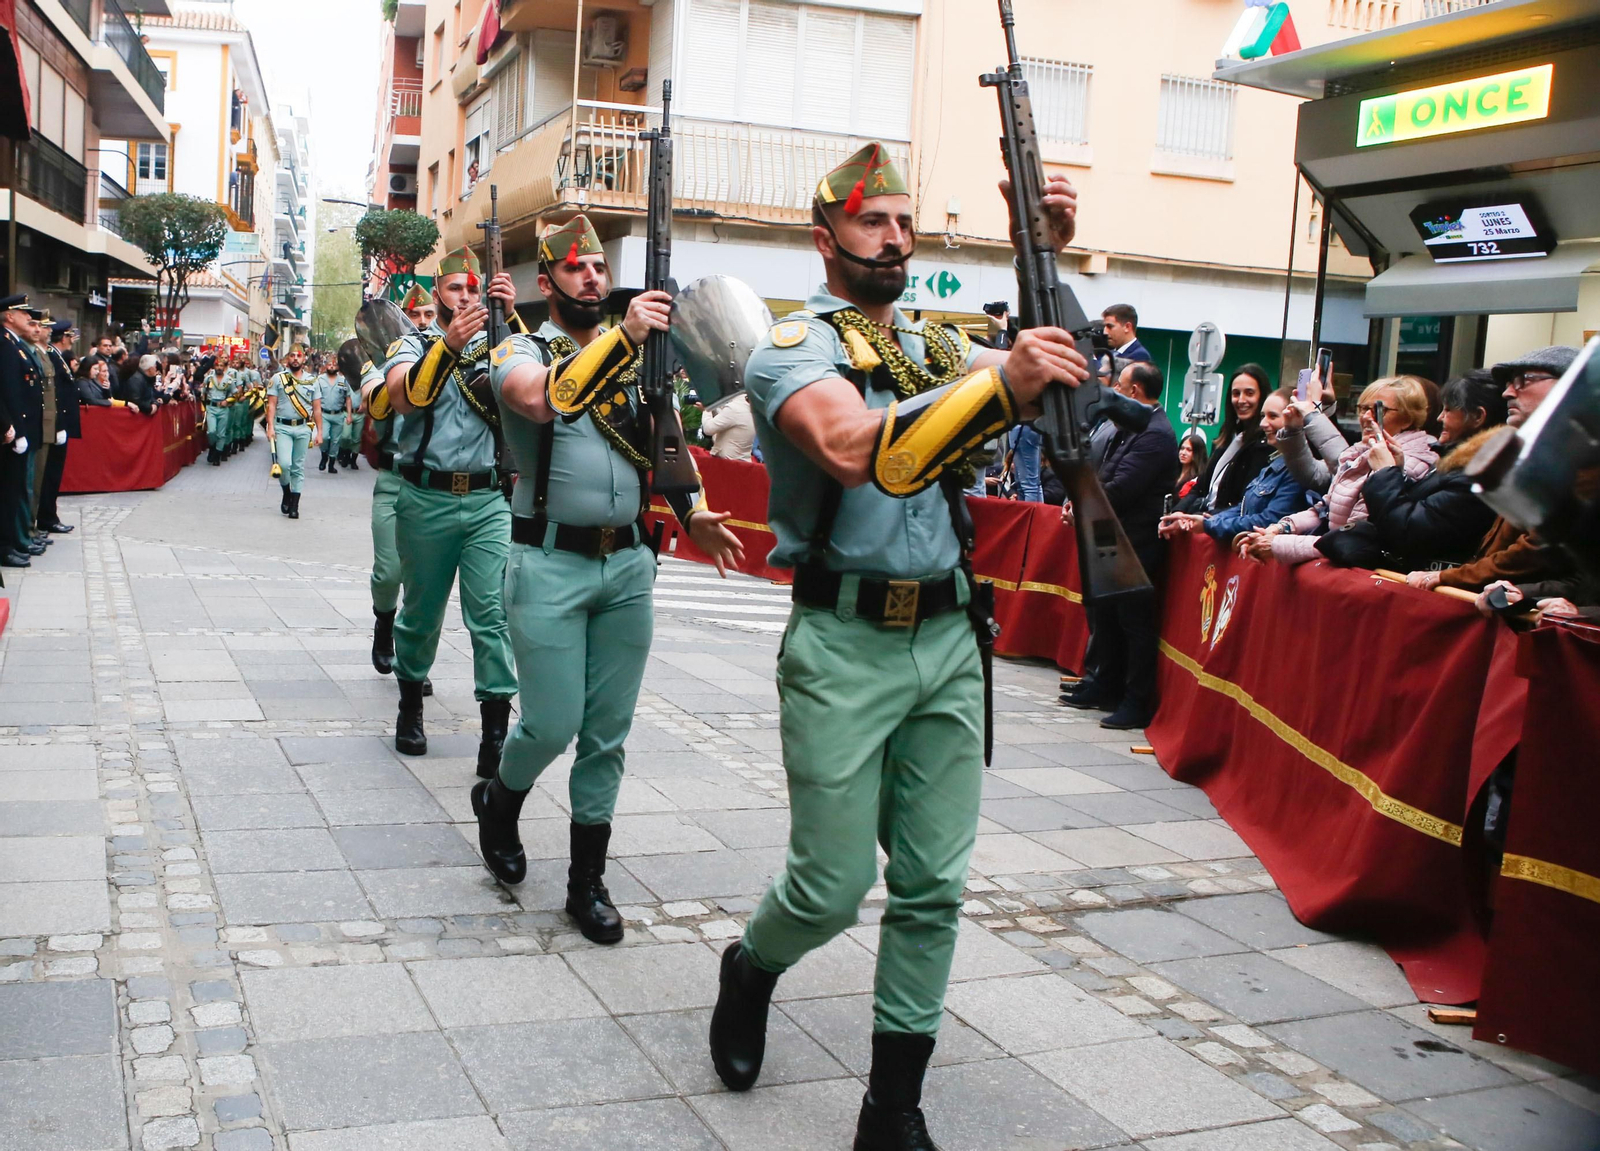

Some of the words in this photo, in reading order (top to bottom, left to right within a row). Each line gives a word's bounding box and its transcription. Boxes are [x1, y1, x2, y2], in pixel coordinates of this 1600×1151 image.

[1410, 76, 1532, 128] ONCE
[1481, 217, 1512, 227] LUNES
[1483, 228, 1494, 236] 25
[1495, 227, 1520, 235] Marzo
[1467, 241, 1501, 255] 732
